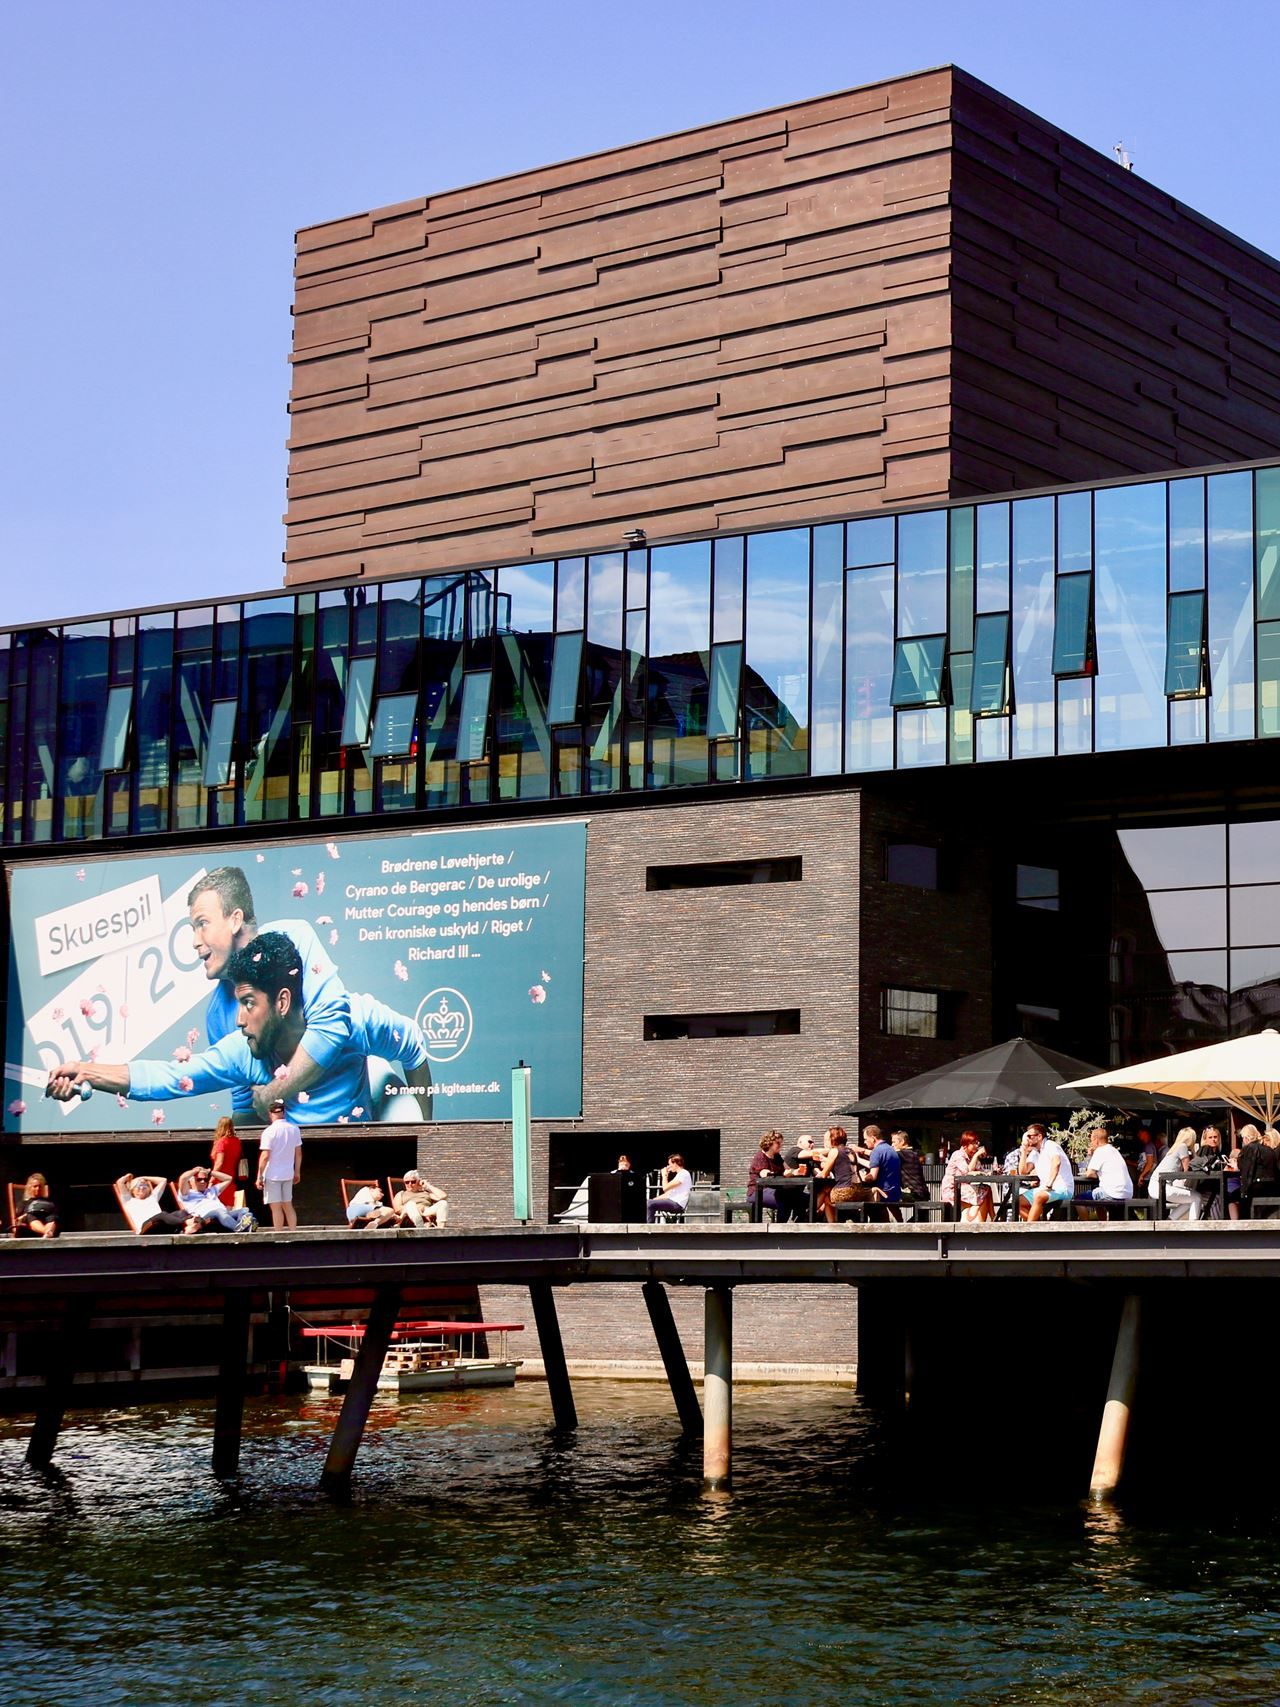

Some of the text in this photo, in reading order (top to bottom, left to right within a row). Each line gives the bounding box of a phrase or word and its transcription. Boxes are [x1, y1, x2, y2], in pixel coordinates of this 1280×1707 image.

[381, 860, 438, 874] Brødrene
[440, 854, 505, 870] Løvehjerte
[346, 885, 388, 900] Cyrano
[391, 882, 407, 895] de
[409, 879, 465, 896] Bergerac
[477, 875, 495, 889] De
[498, 873, 541, 889] urolige
[345, 907, 384, 920] Mutter
[387, 903, 440, 919] Courage
[443, 903, 460, 917] og
[462, 898, 508, 913] hendes
[510, 896, 540, 910] børn
[49, 893, 151, 956] Skuespil
[359, 928, 383, 941] Den
[385, 924, 437, 940] kroniske
[440, 921, 479, 939] uskyld
[491, 919, 524, 937] Riget
[408, 946, 455, 961] Richard
[385, 1081, 500, 1097] Se mere på kglteater.dk
